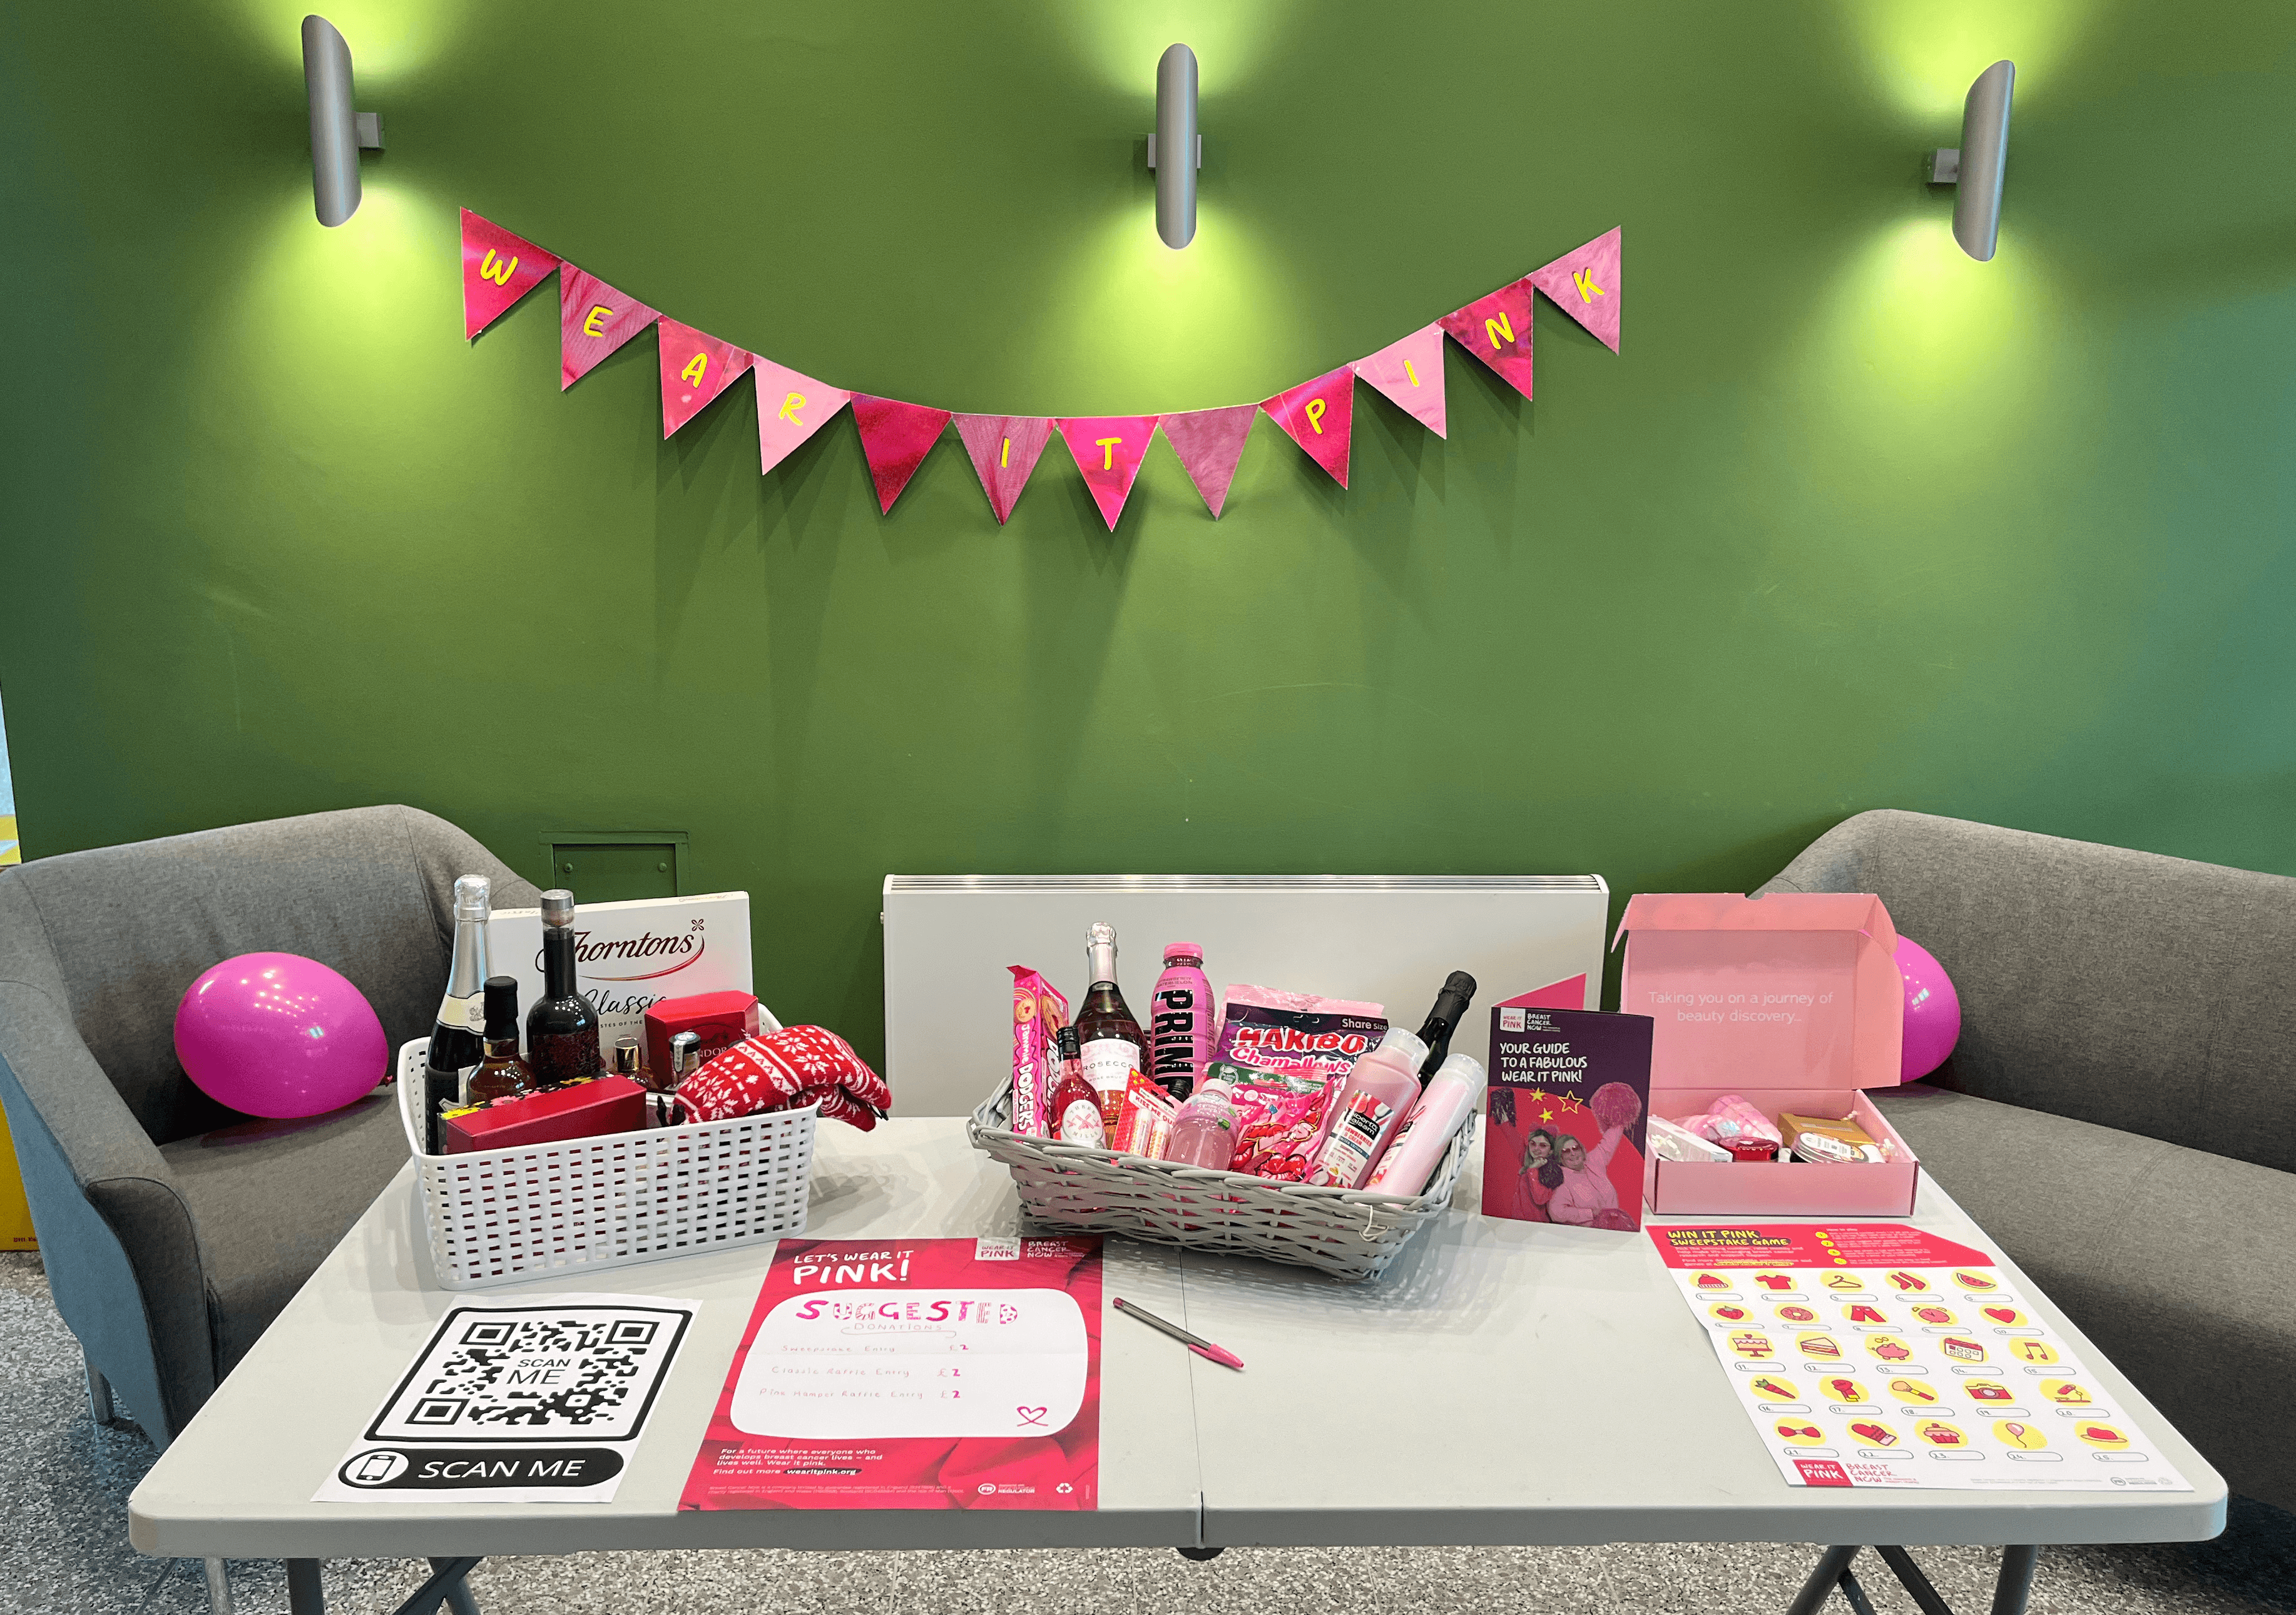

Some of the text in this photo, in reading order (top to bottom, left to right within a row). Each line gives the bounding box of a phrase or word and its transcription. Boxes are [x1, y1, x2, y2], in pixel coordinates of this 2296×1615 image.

[480, 249, 1605, 470] WEAR IT PINK
[1648, 991, 1834, 1007] Taking you on a journey of
[1676, 1008, 1725, 1024] beauty
[1342, 1018, 1372, 1030] Share
[1503, 1020, 1522, 1028] PINK
[1021, 1023, 1030, 1064] Jammie
[1236, 1027, 1368, 1054] HARIBO
[700, 1047, 727, 1058] NDOR
[1499, 1042, 1570, 1054] YOUR GUIDE
[1083, 1060, 1134, 1071] ROSECCO
[1230, 1047, 1353, 1074] Chamallows
[1501, 1056, 1588, 1069] TO A FABULOUS
[1501, 1069, 1582, 1083] WEAR IT PINK!
[1018, 1062, 1034, 1132] DODGERS
[1069, 1104, 1096, 1114] THREE
[1135, 1095, 1150, 1109] KISS
[1151, 1107, 1161, 1117] ME
[1072, 1130, 1098, 1139] MILLS
[1338, 1124, 1372, 1146] SAWBERRIES
[1667, 1230, 1760, 1239] WIN IT PINK
[793, 1249, 914, 1263] LET'S WEAR IT
[793, 1259, 909, 1284] PINK!
[795, 1300, 1018, 1325] SUGGESTED
[517, 1358, 571, 1368] SCAN
[506, 1369, 566, 1385] ME
[772, 1366, 819, 1375] Classic
[876, 1368, 909, 1378] Entry
[759, 1388, 786, 1396] Pink
[890, 1391, 923, 1400] Entry
[417, 1459, 586, 1479] SCAN ME
[1803, 1469, 1844, 1479] PINK
